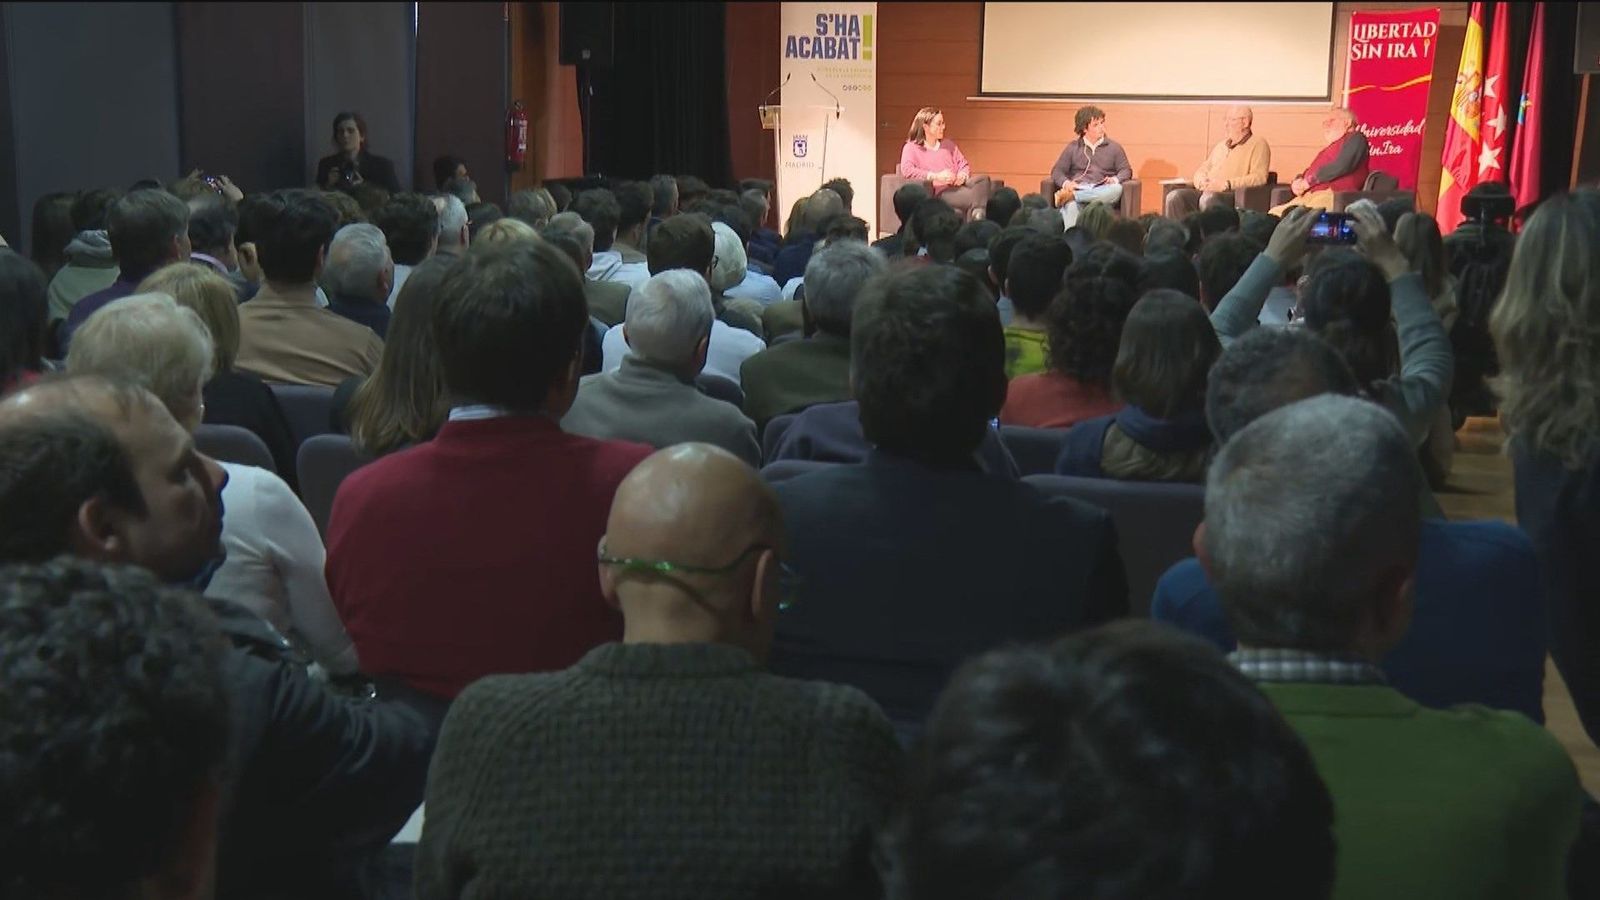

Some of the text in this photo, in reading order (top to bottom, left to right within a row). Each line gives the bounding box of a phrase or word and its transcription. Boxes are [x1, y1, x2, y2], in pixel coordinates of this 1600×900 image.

[816, 13, 860, 36] S'HA
[1353, 21, 1437, 43] LIBERTAD
[1351, 43, 1417, 60] SIN IRA
